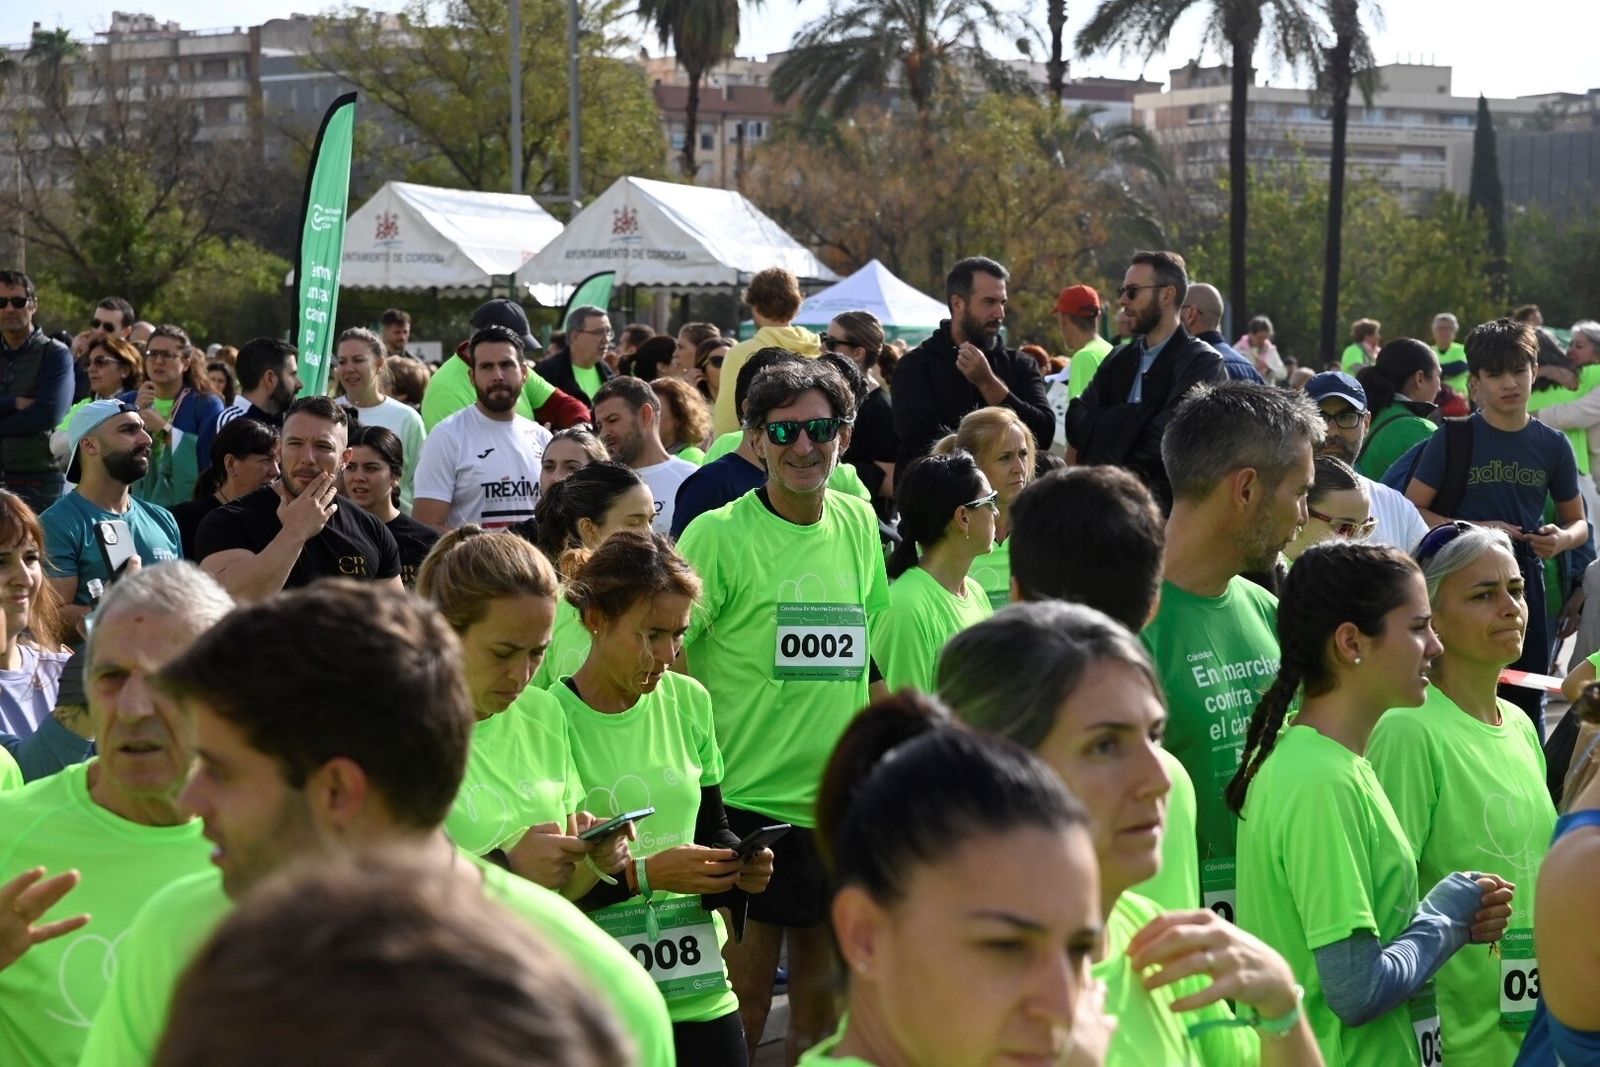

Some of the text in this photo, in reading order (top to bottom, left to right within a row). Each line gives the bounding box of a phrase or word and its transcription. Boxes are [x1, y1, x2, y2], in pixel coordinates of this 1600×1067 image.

[632, 248, 644, 259] DE
[781, 633, 853, 658] 0002
[1191, 664, 1220, 688] En
[1205, 687, 1253, 713] contra
[1209, 716, 1227, 740] el
[594, 911, 623, 921] Córdoba
[1504, 933, 1532, 941] Córdoba
